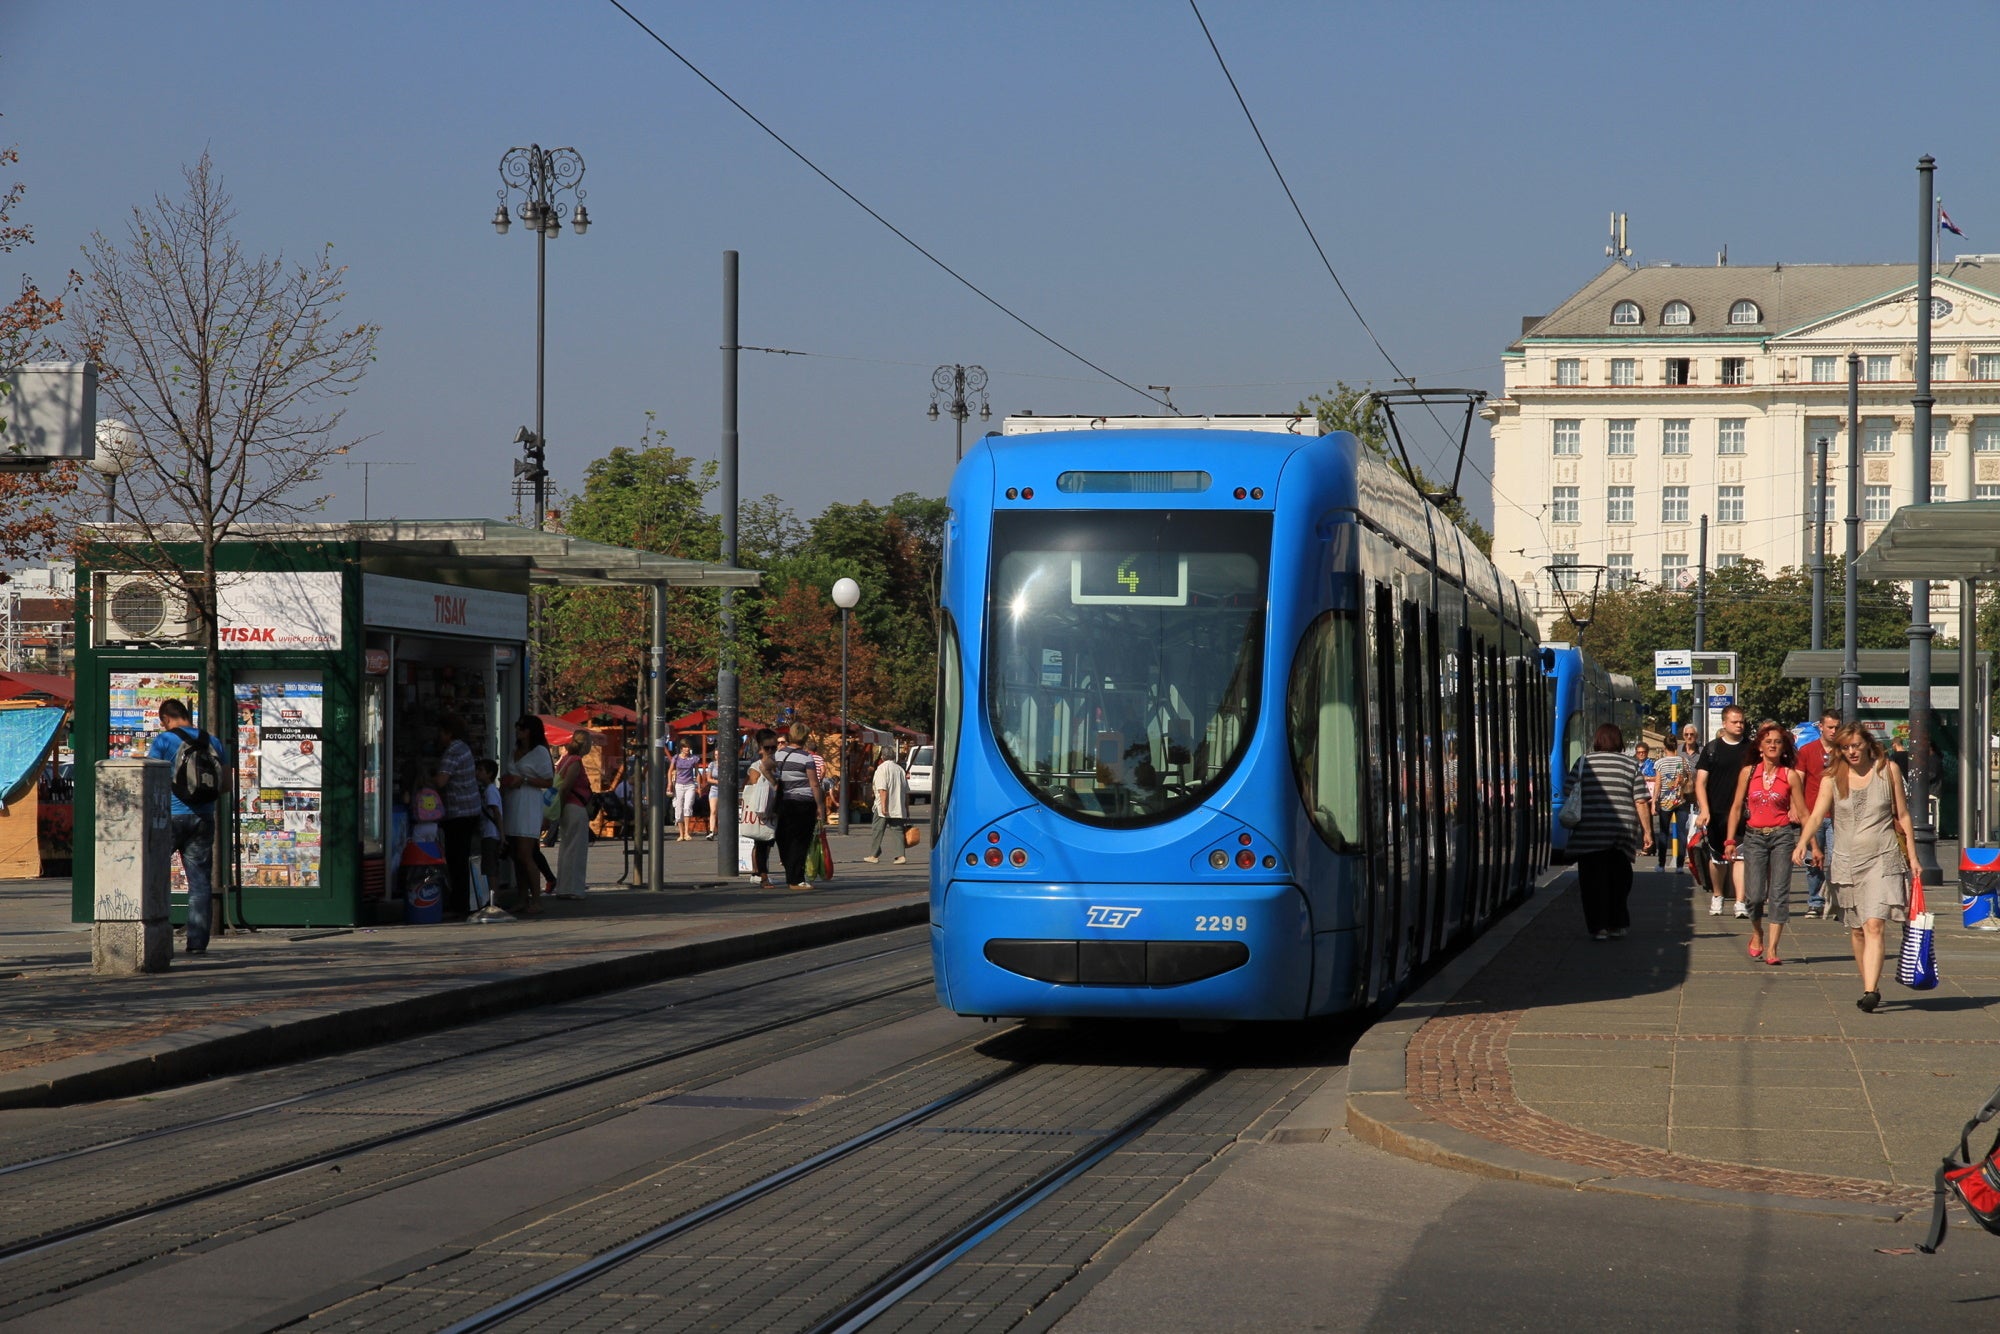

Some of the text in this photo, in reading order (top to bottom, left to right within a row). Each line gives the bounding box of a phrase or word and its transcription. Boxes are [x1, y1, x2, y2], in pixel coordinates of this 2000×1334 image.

[1118, 554, 1139, 593] 4
[1682, 575, 1689, 583] S
[434, 595, 467, 626] TISAK
[219, 627, 276, 642] TISAK
[278, 634, 303, 643] uvijek
[1086, 905, 1143, 929] ZET
[1195, 915, 1247, 932] 2299
